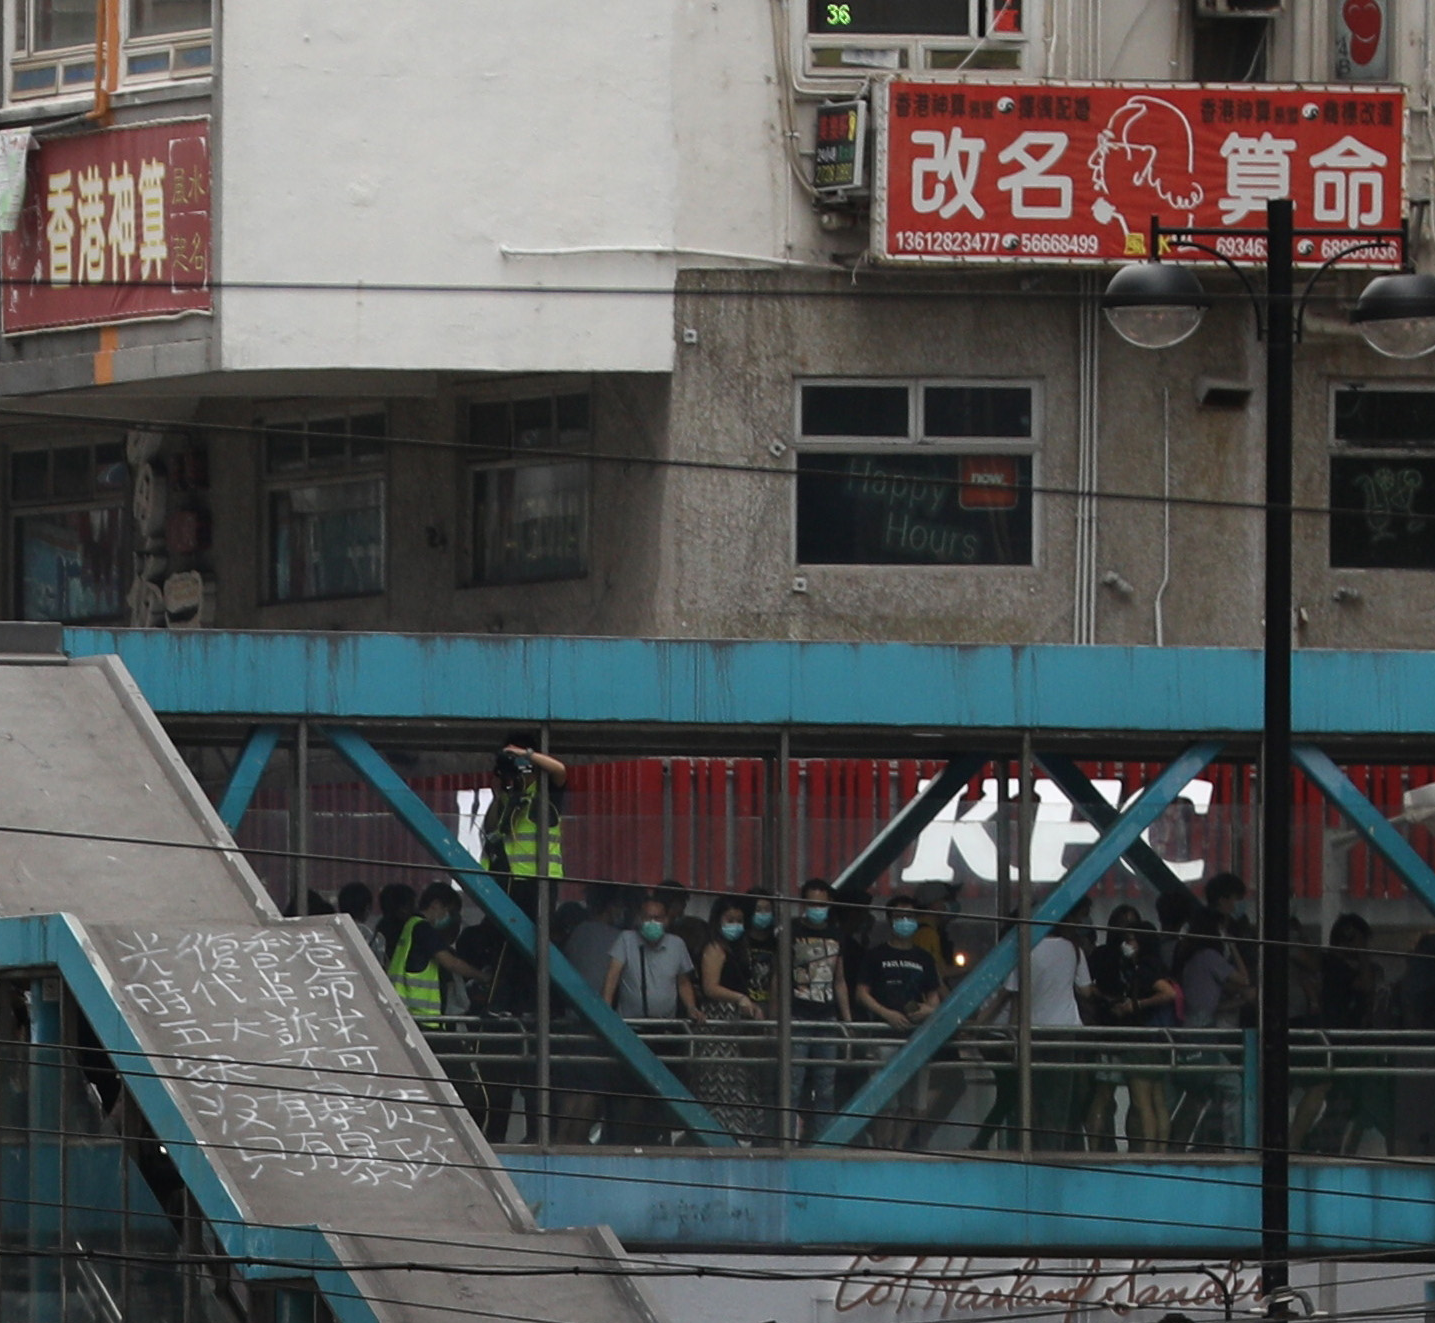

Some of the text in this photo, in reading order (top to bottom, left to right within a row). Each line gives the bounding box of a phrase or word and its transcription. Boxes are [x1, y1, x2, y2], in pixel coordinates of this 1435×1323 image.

[827, 4, 851, 25] 36
[911, 127, 1072, 220] 改名
[1219, 132, 1387, 229] 算命
[47, 157, 167, 288] 香港神算
[896, 232, 1098, 253] 13612823477 56668499
[848, 457, 947, 510] Happy
[887, 511, 977, 559] Hours
[901, 778, 1214, 882] KFC
[117, 929, 345, 977] 光復香港
[124, 966, 358, 1016] 時代革命
[159, 1005, 369, 1048] 五大訴求
